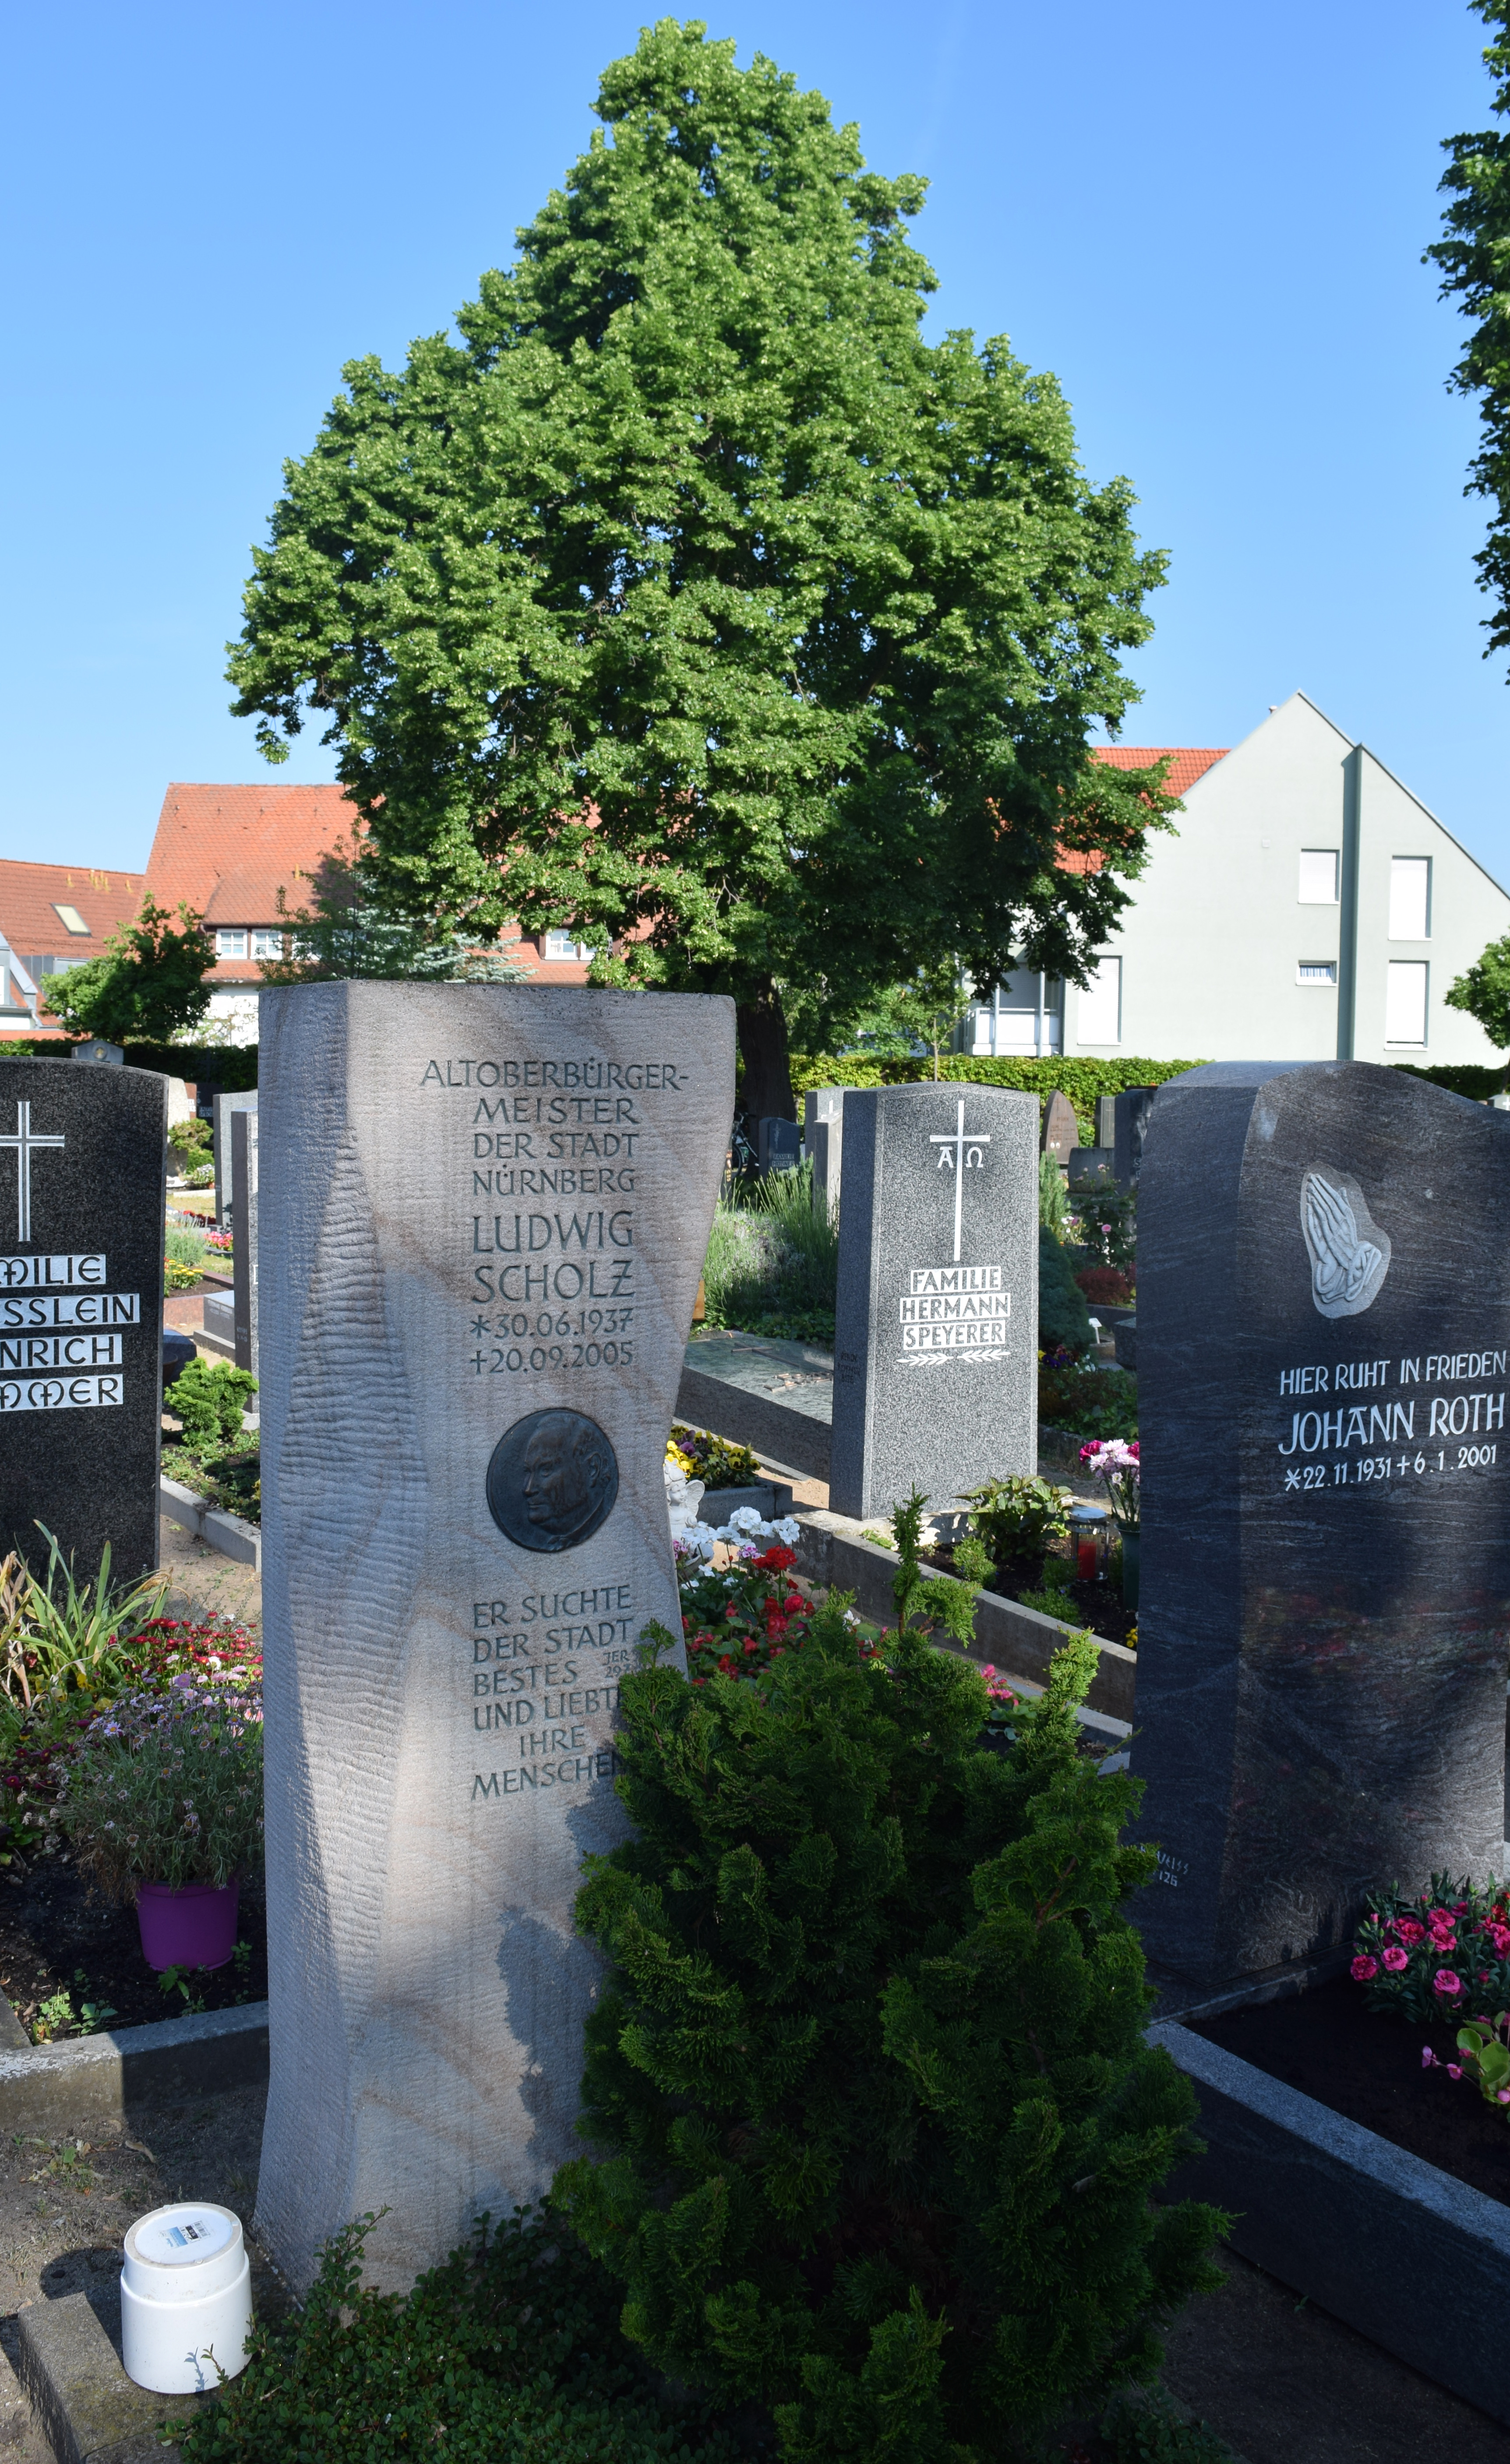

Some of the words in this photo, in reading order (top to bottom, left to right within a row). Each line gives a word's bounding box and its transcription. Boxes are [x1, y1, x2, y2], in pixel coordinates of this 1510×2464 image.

[420, 1057, 689, 1091] ALTOBERBÜRGER-
[473, 1097, 640, 1125] MEISTER
[473, 1133, 537, 1159] DER
[547, 1133, 639, 1158] STADT
[473, 1164, 635, 1197] NÜRNBERG
[473, 1211, 635, 1254] LUDWIG
[473, 1260, 635, 1305] SCHOLZ
[913, 1269, 999, 1292] FAMILIE
[4, 1295, 134, 1326] SSLEIN
[902, 1295, 1009, 1320] HERMANN
[0, 1336, 114, 1368] NRICH
[906, 1323, 1004, 1348] SPEYERER
[1280, 1366, 1328, 1395] HIER
[1335, 1360, 1390, 1390] RUHT
[1400, 1357, 1420, 1384] IN
[1425, 1350, 1507, 1382] FRIEDEN
[1278, 1401, 1415, 1455] JOHANN
[1429, 1392, 1505, 1437] ROTH
[473, 1601, 512, 1630] ER
[521, 1584, 633, 1623] SUCHTE
[473, 1633, 529, 1664] DER
[544, 1618, 634, 1654] STADT
[473, 1661, 578, 1697] BESTES
[474, 1700, 534, 1732] UND
[544, 1686, 623, 1721] LIEBT
[520, 1724, 586, 1759] IHRE
